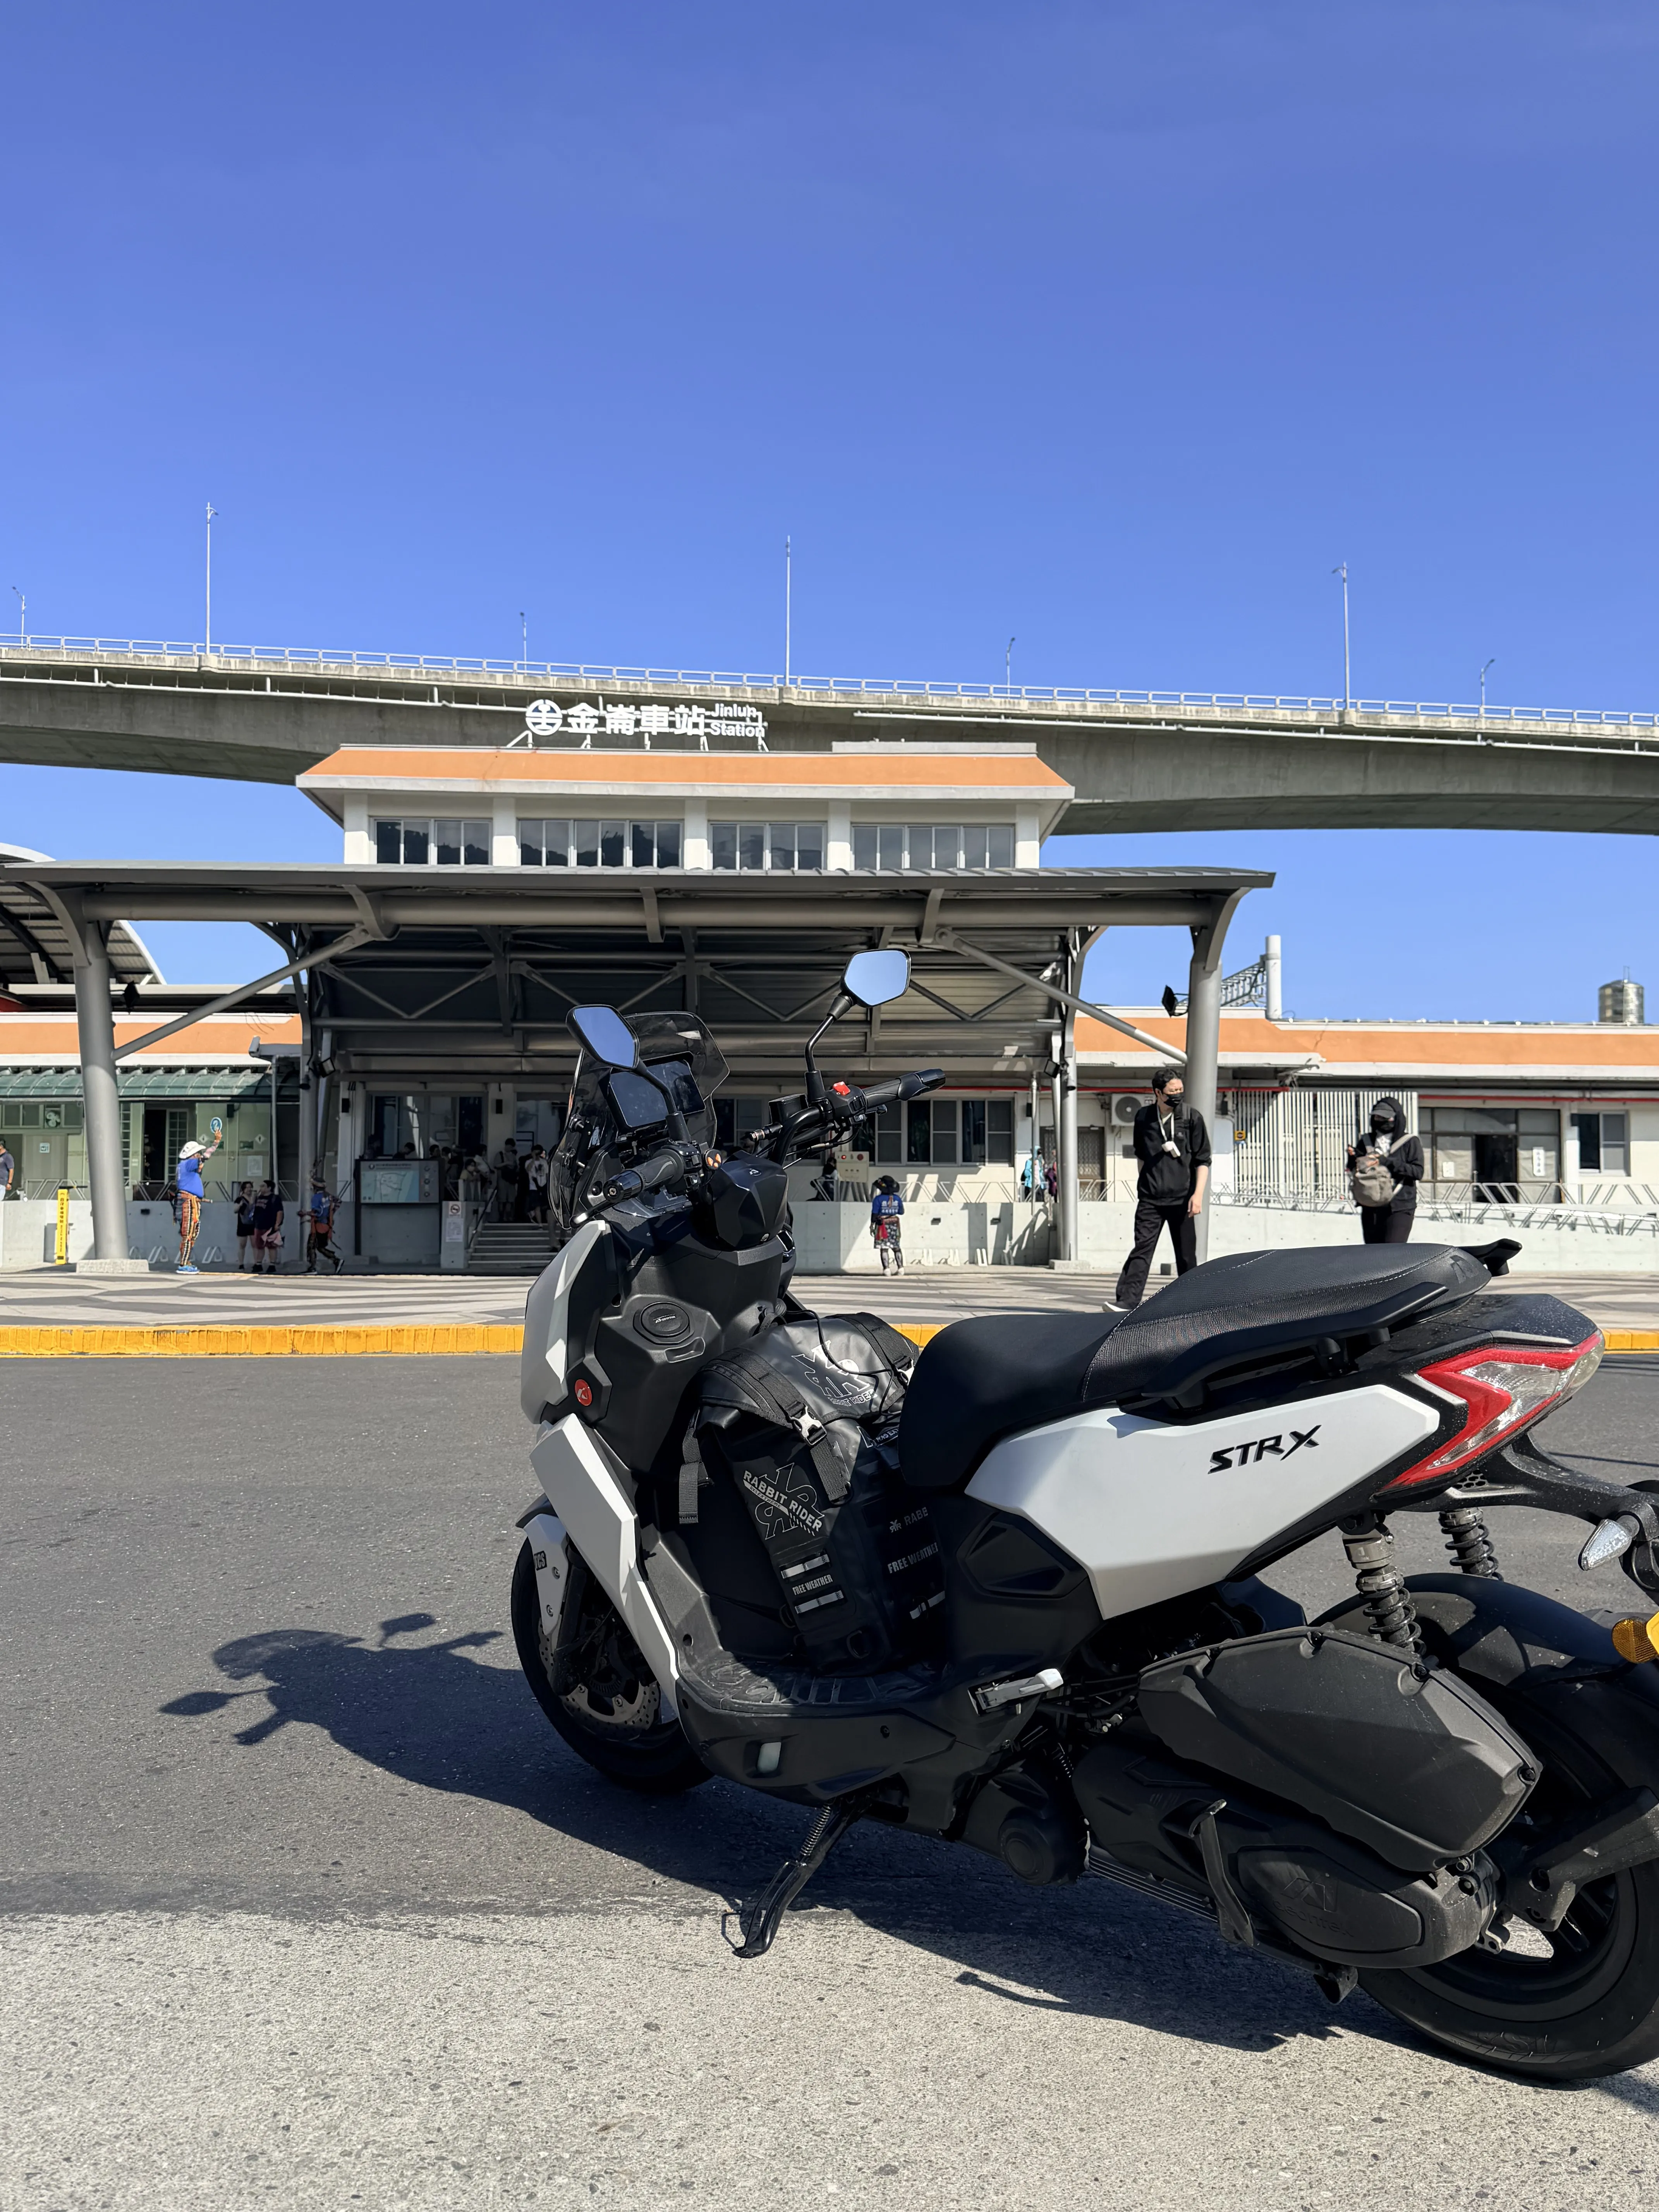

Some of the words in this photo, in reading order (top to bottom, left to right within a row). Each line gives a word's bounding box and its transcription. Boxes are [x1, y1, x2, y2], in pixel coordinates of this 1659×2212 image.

[567, 702, 706, 736] 金崙車站
[711, 703, 757, 718] Jinlun
[710, 722, 765, 738] Station
[743, 1470, 788, 1504] RABBIT
[789, 1500, 823, 1532] RIDER
[887, 1558, 908, 1574] FREE
[792, 1584, 807, 1595] FREE
[804, 1574, 833, 1590] WEATHER
